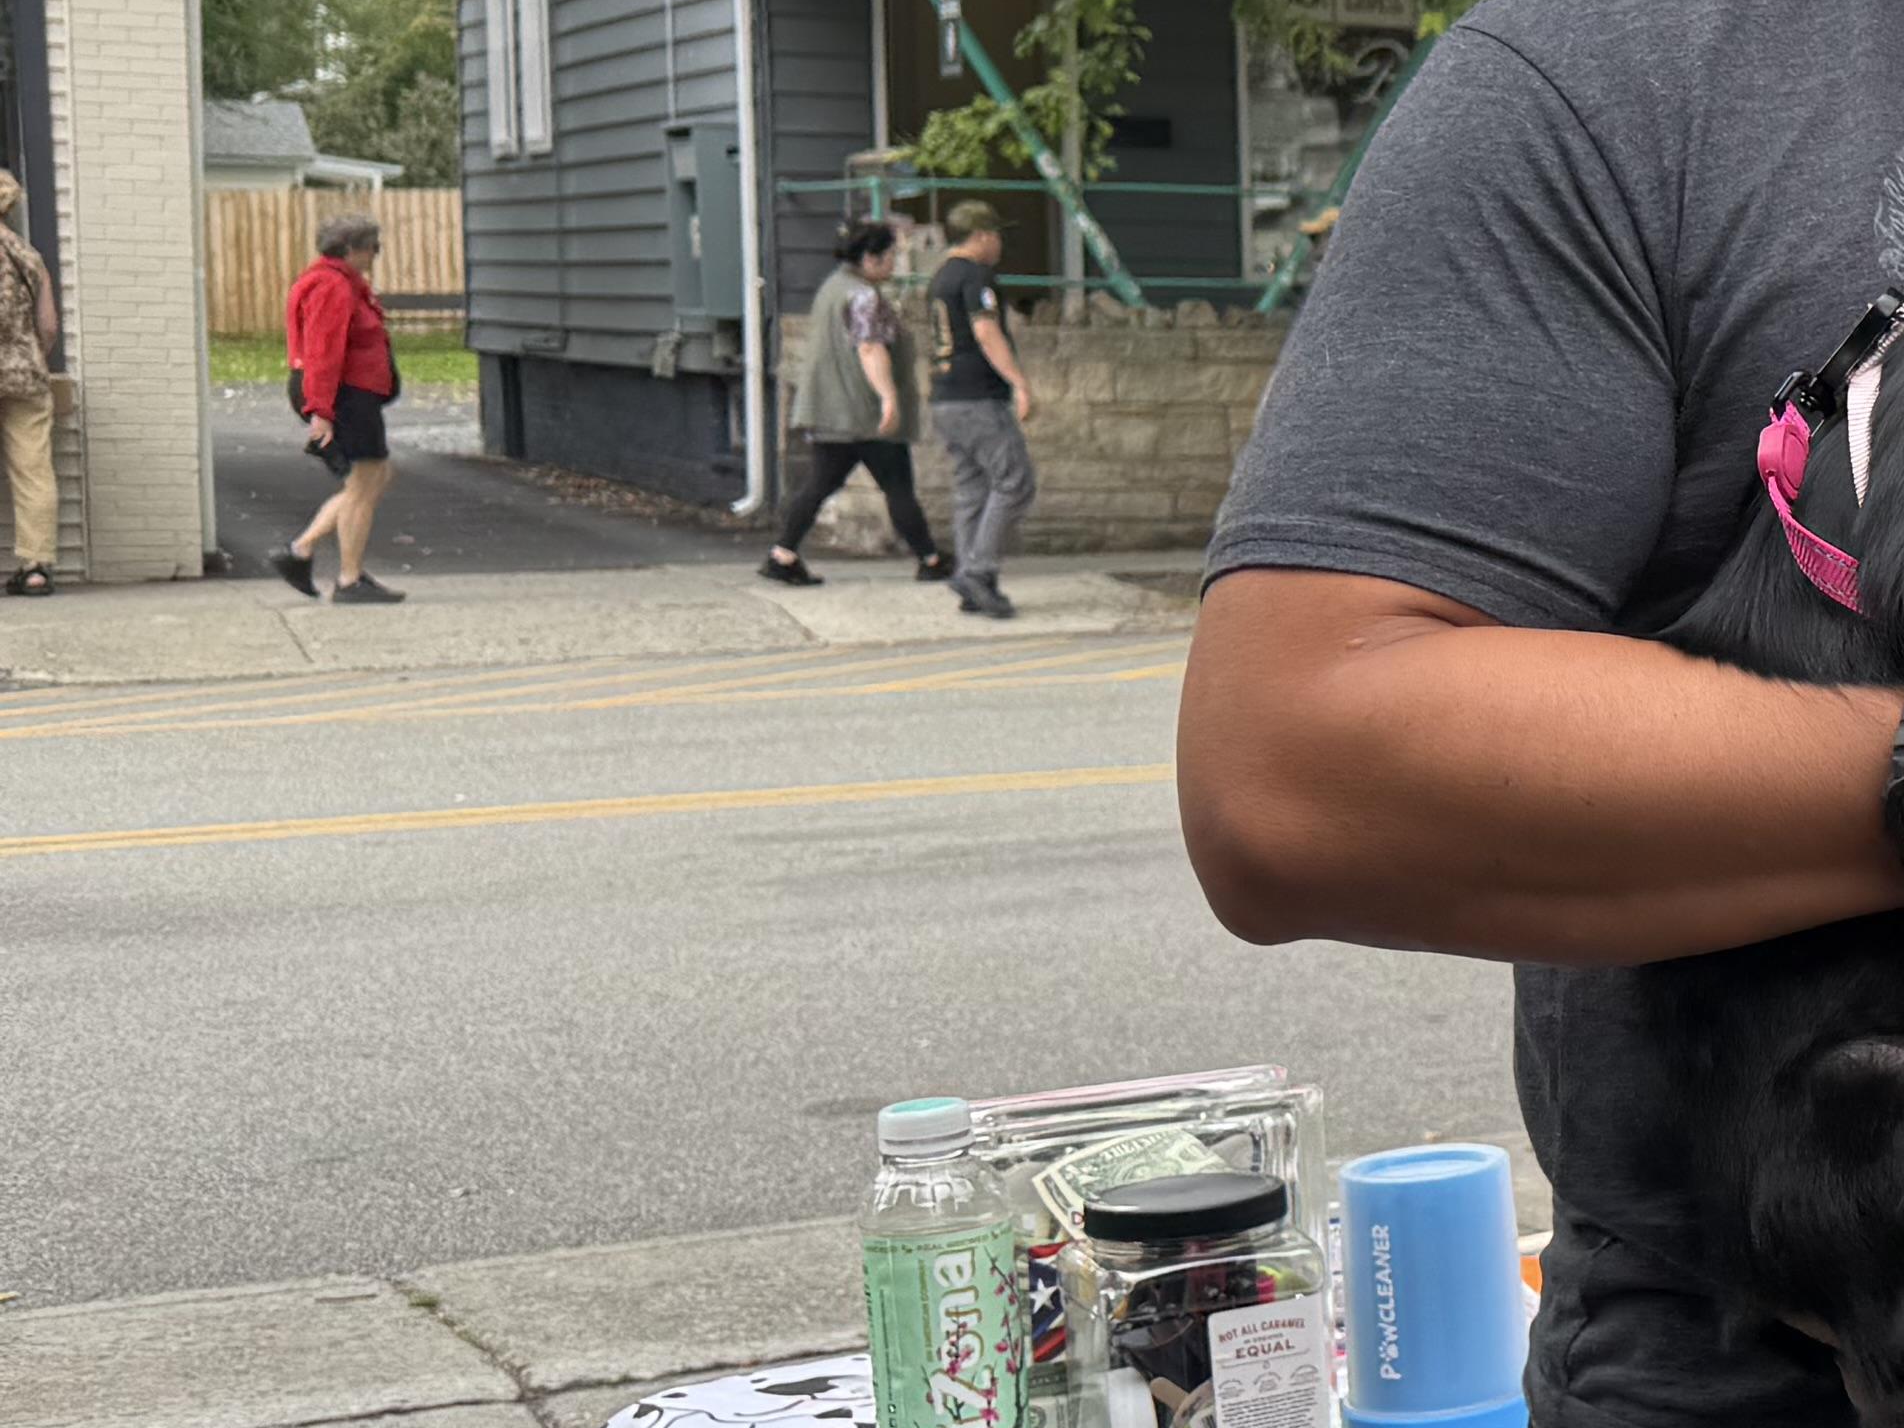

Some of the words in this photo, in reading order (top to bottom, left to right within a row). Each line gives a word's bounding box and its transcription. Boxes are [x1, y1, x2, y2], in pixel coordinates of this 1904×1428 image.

[1218, 1328, 1238, 1343] NOT
[1241, 1323, 1258, 1335] ALL
[1261, 1317, 1305, 1332] CARAMEL
[1235, 1339, 1295, 1360] EQUAL
